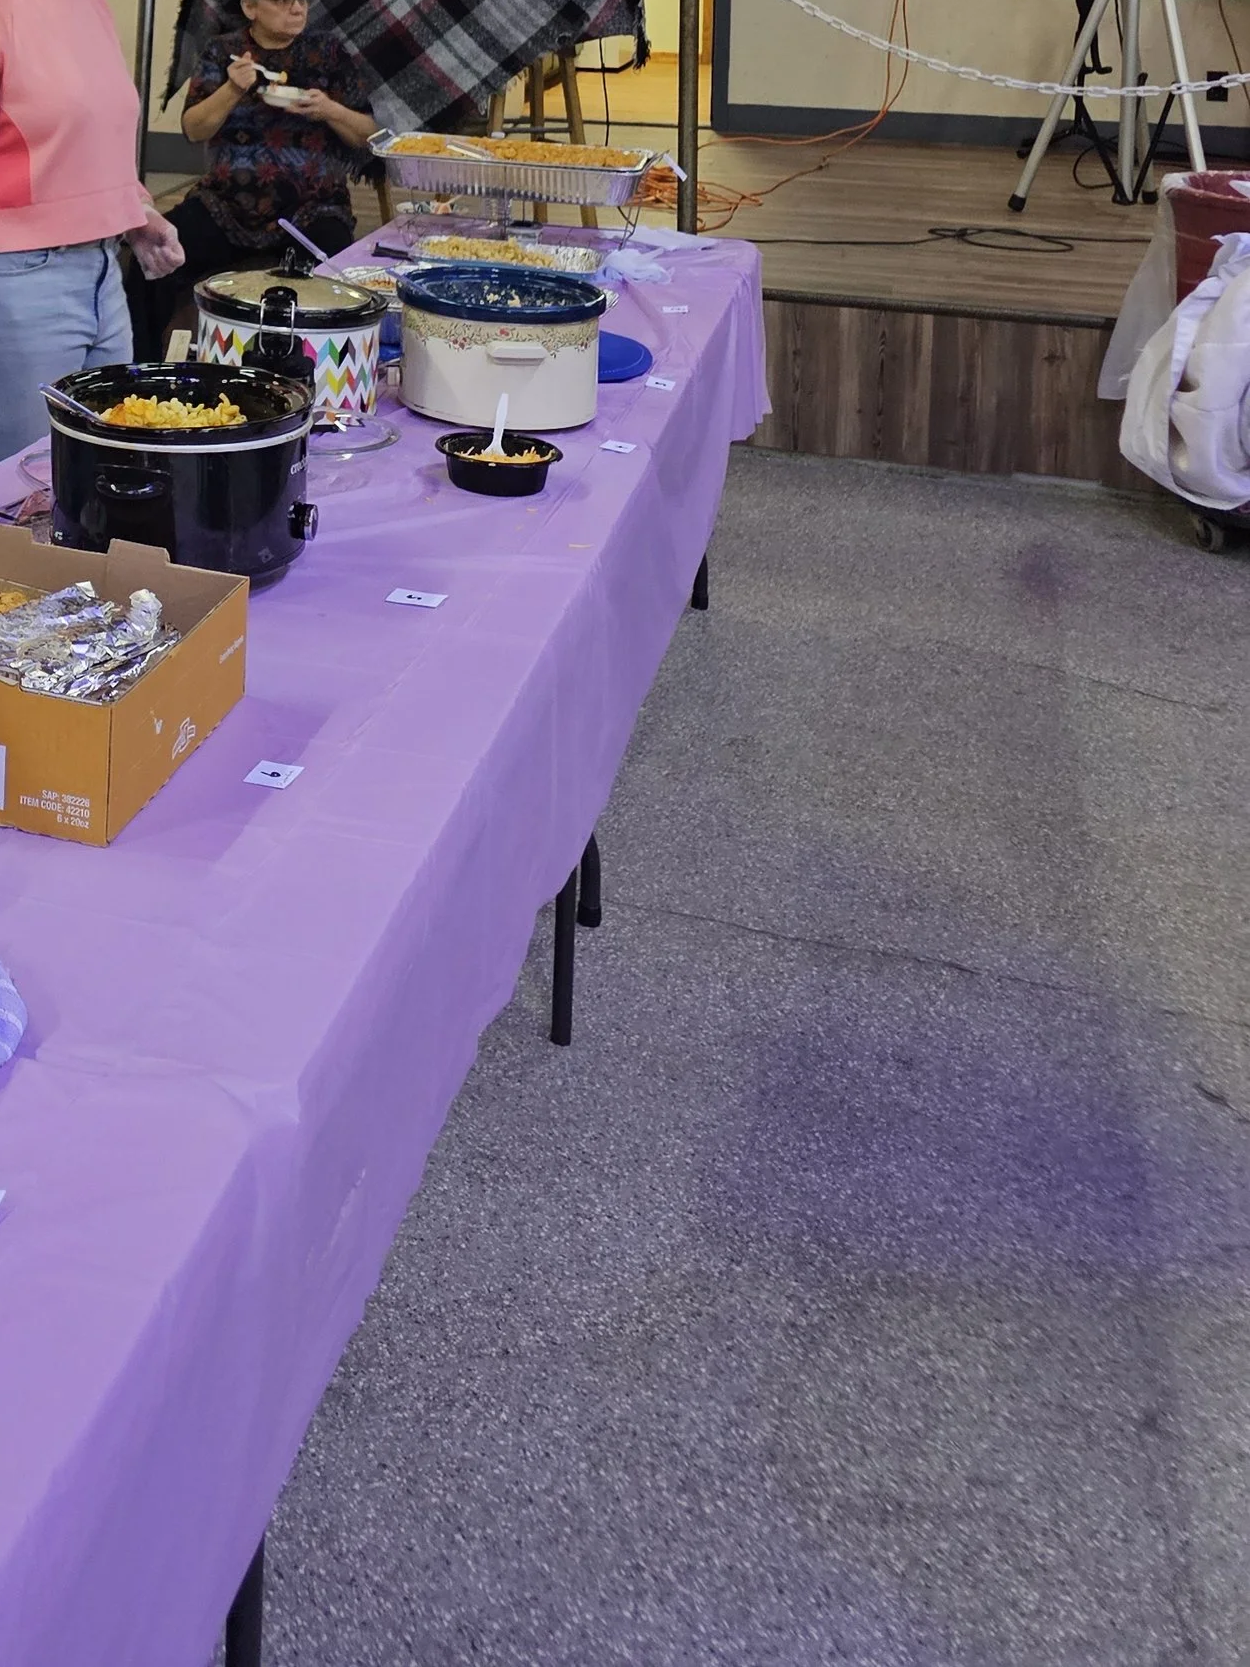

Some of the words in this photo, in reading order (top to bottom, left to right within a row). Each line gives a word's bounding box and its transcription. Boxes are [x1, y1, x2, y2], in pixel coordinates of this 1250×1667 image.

[41, 790, 60, 801] SAP:
[19, 795, 39, 808] ITEM
[41, 798, 64, 813] CODE:
